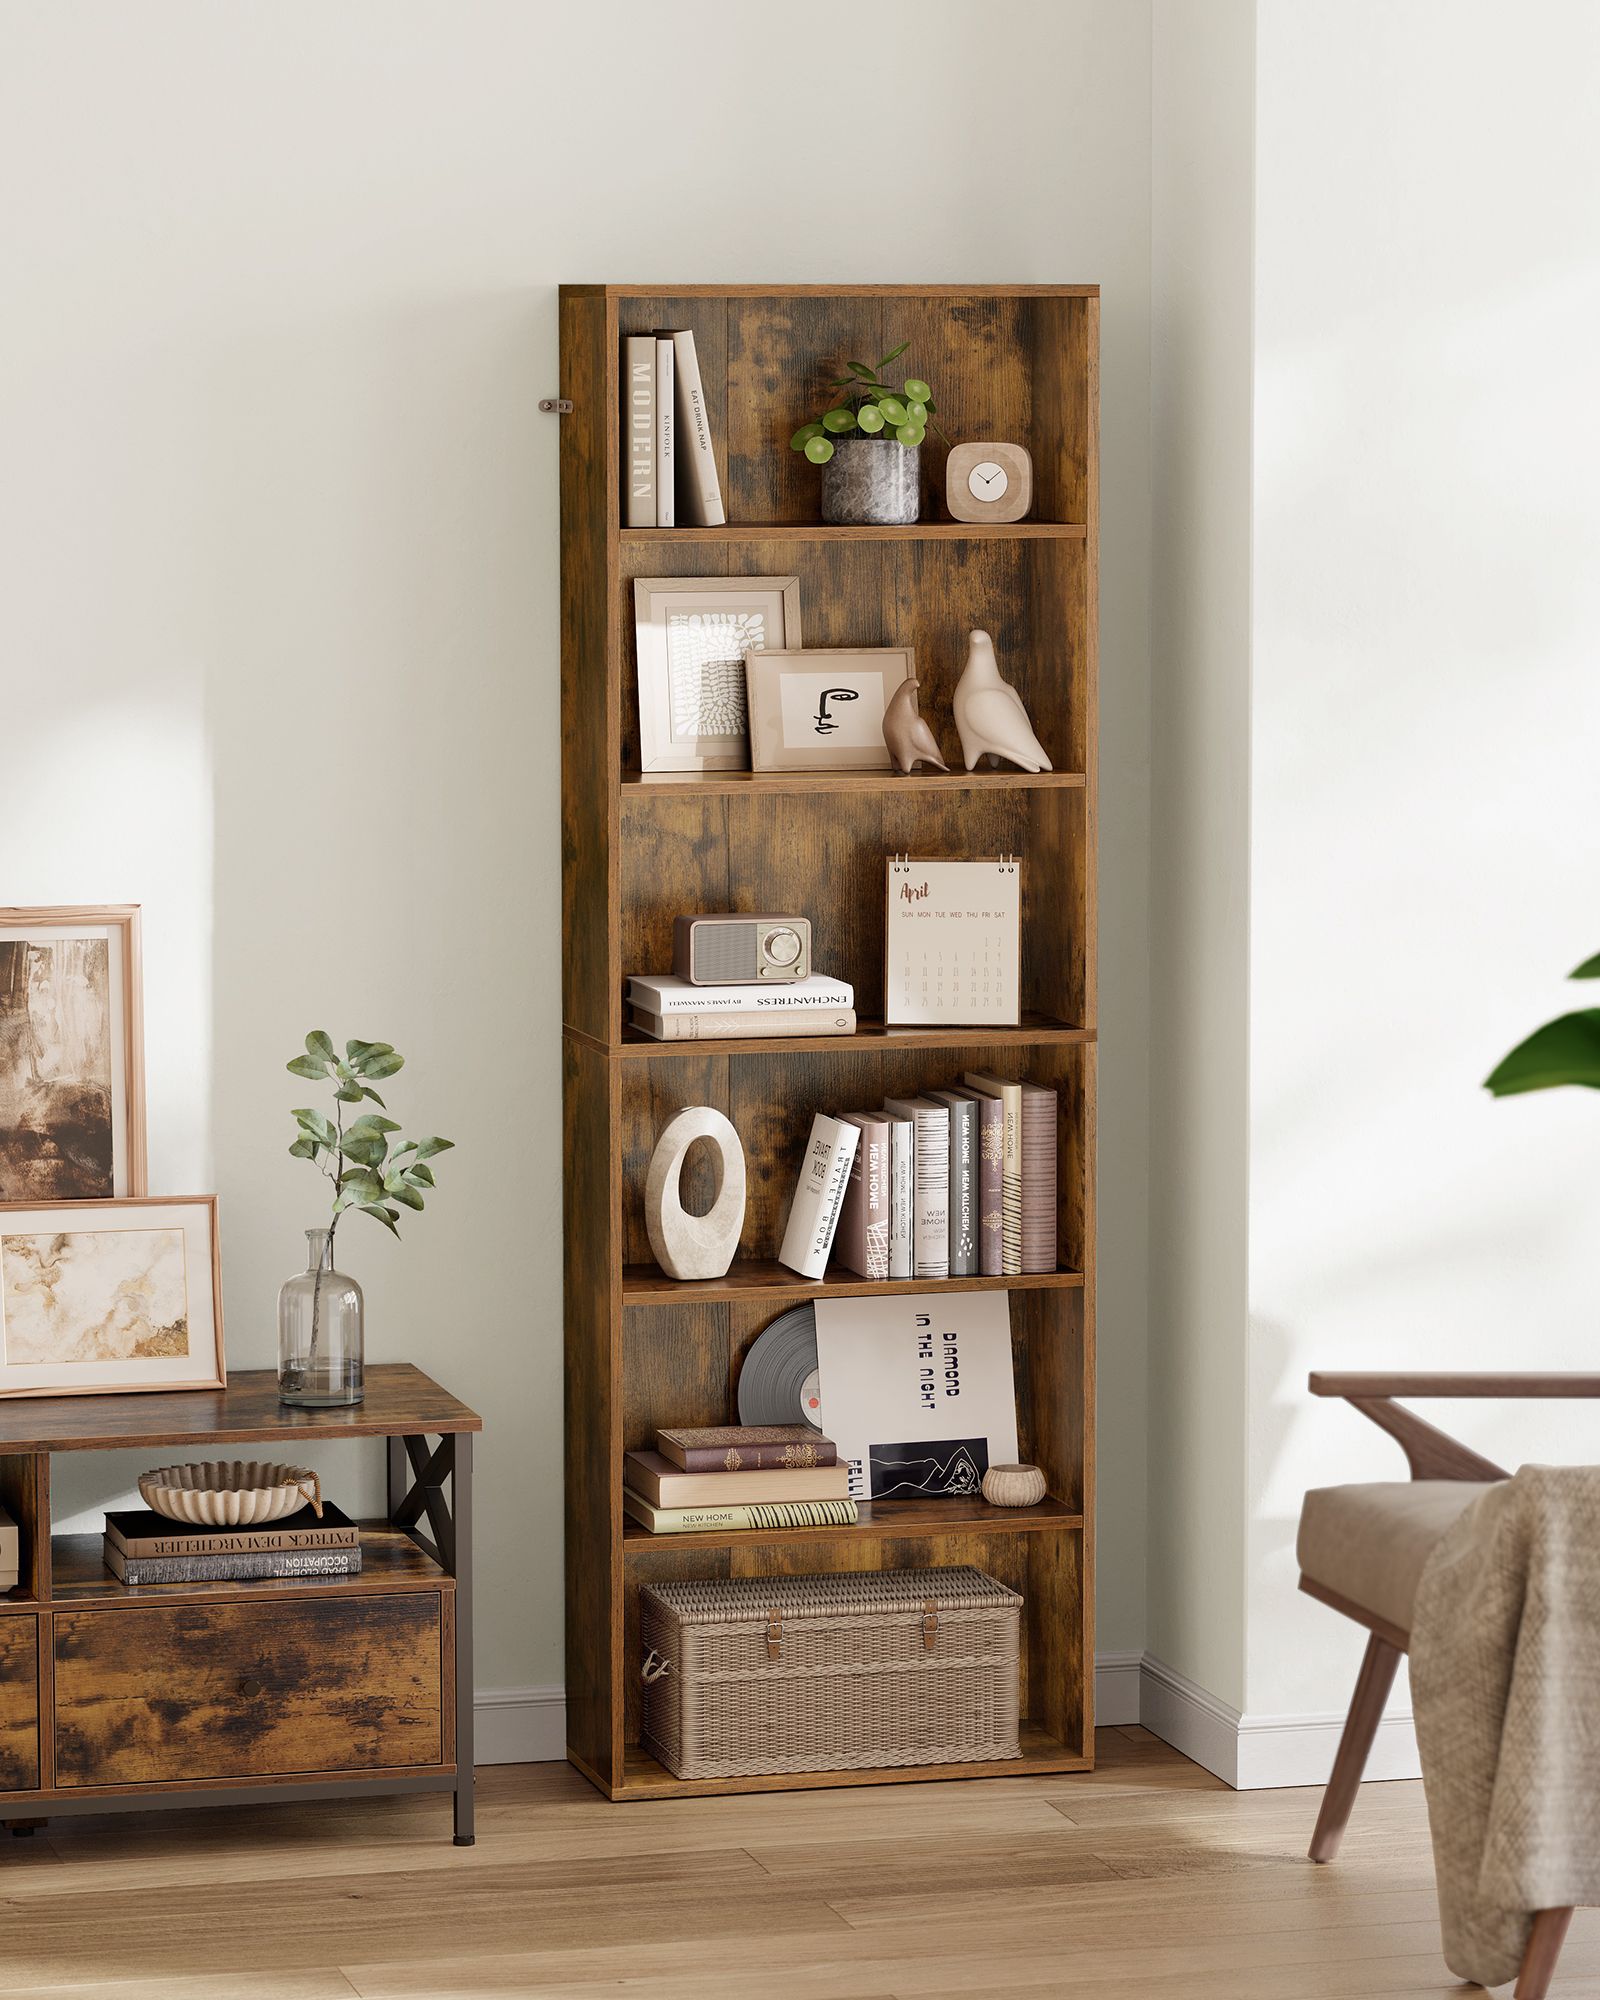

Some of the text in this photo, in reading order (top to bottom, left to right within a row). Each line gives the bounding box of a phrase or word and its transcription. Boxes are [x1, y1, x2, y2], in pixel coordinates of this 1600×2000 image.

[632, 363, 651, 498] MODERN
[691, 390, 707, 451] EAT DRINK NAP
[900, 882, 931, 904] April
[757, 995, 847, 1006] ENCHANTRESS
[918, 1334, 933, 1358] THE
[706, 1513, 733, 1521] HOME
[154, 1532, 355, 1554] PATRICK DEMARCHELIER
[285, 1556, 349, 1568] OCCUPATION
[321, 1567, 348, 1575] BRAD
